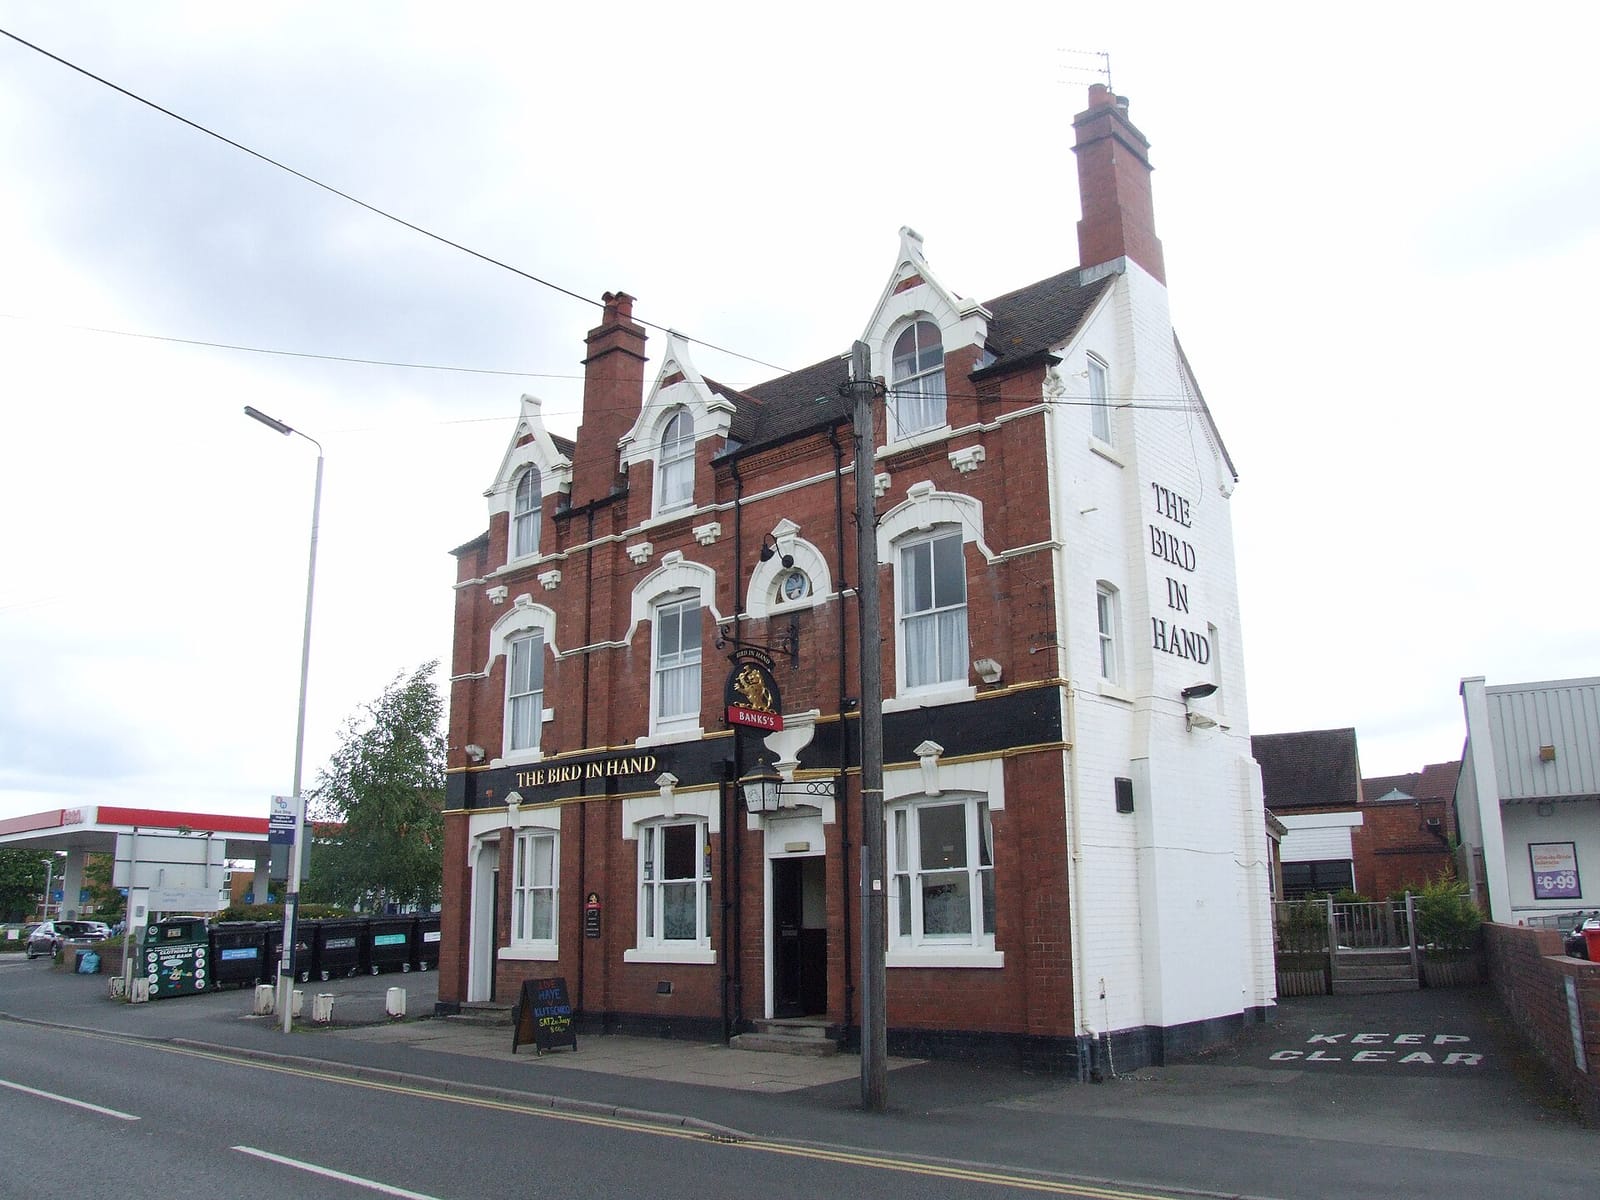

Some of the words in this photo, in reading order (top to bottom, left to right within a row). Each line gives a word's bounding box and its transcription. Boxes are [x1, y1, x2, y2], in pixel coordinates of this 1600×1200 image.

[1151, 481, 1193, 529] THE
[1148, 524, 1197, 573] BIRD
[1165, 576, 1190, 614] IN
[1151, 616, 1210, 666] HAND
[748, 649, 756, 657] IN
[755, 651, 771, 665] HAND
[739, 711, 775, 726] BANKS'S
[516, 770, 545, 788] THE
[547, 765, 582, 784] BIRD
[585, 760, 603, 779] IN
[605, 755, 656, 777] HAND
[539, 989, 560, 1000] HAYE
[538, 1017, 551, 1027] SAT
[1306, 1033, 1471, 1045] KEEP
[1268, 1050, 1485, 1065] CLEAR
